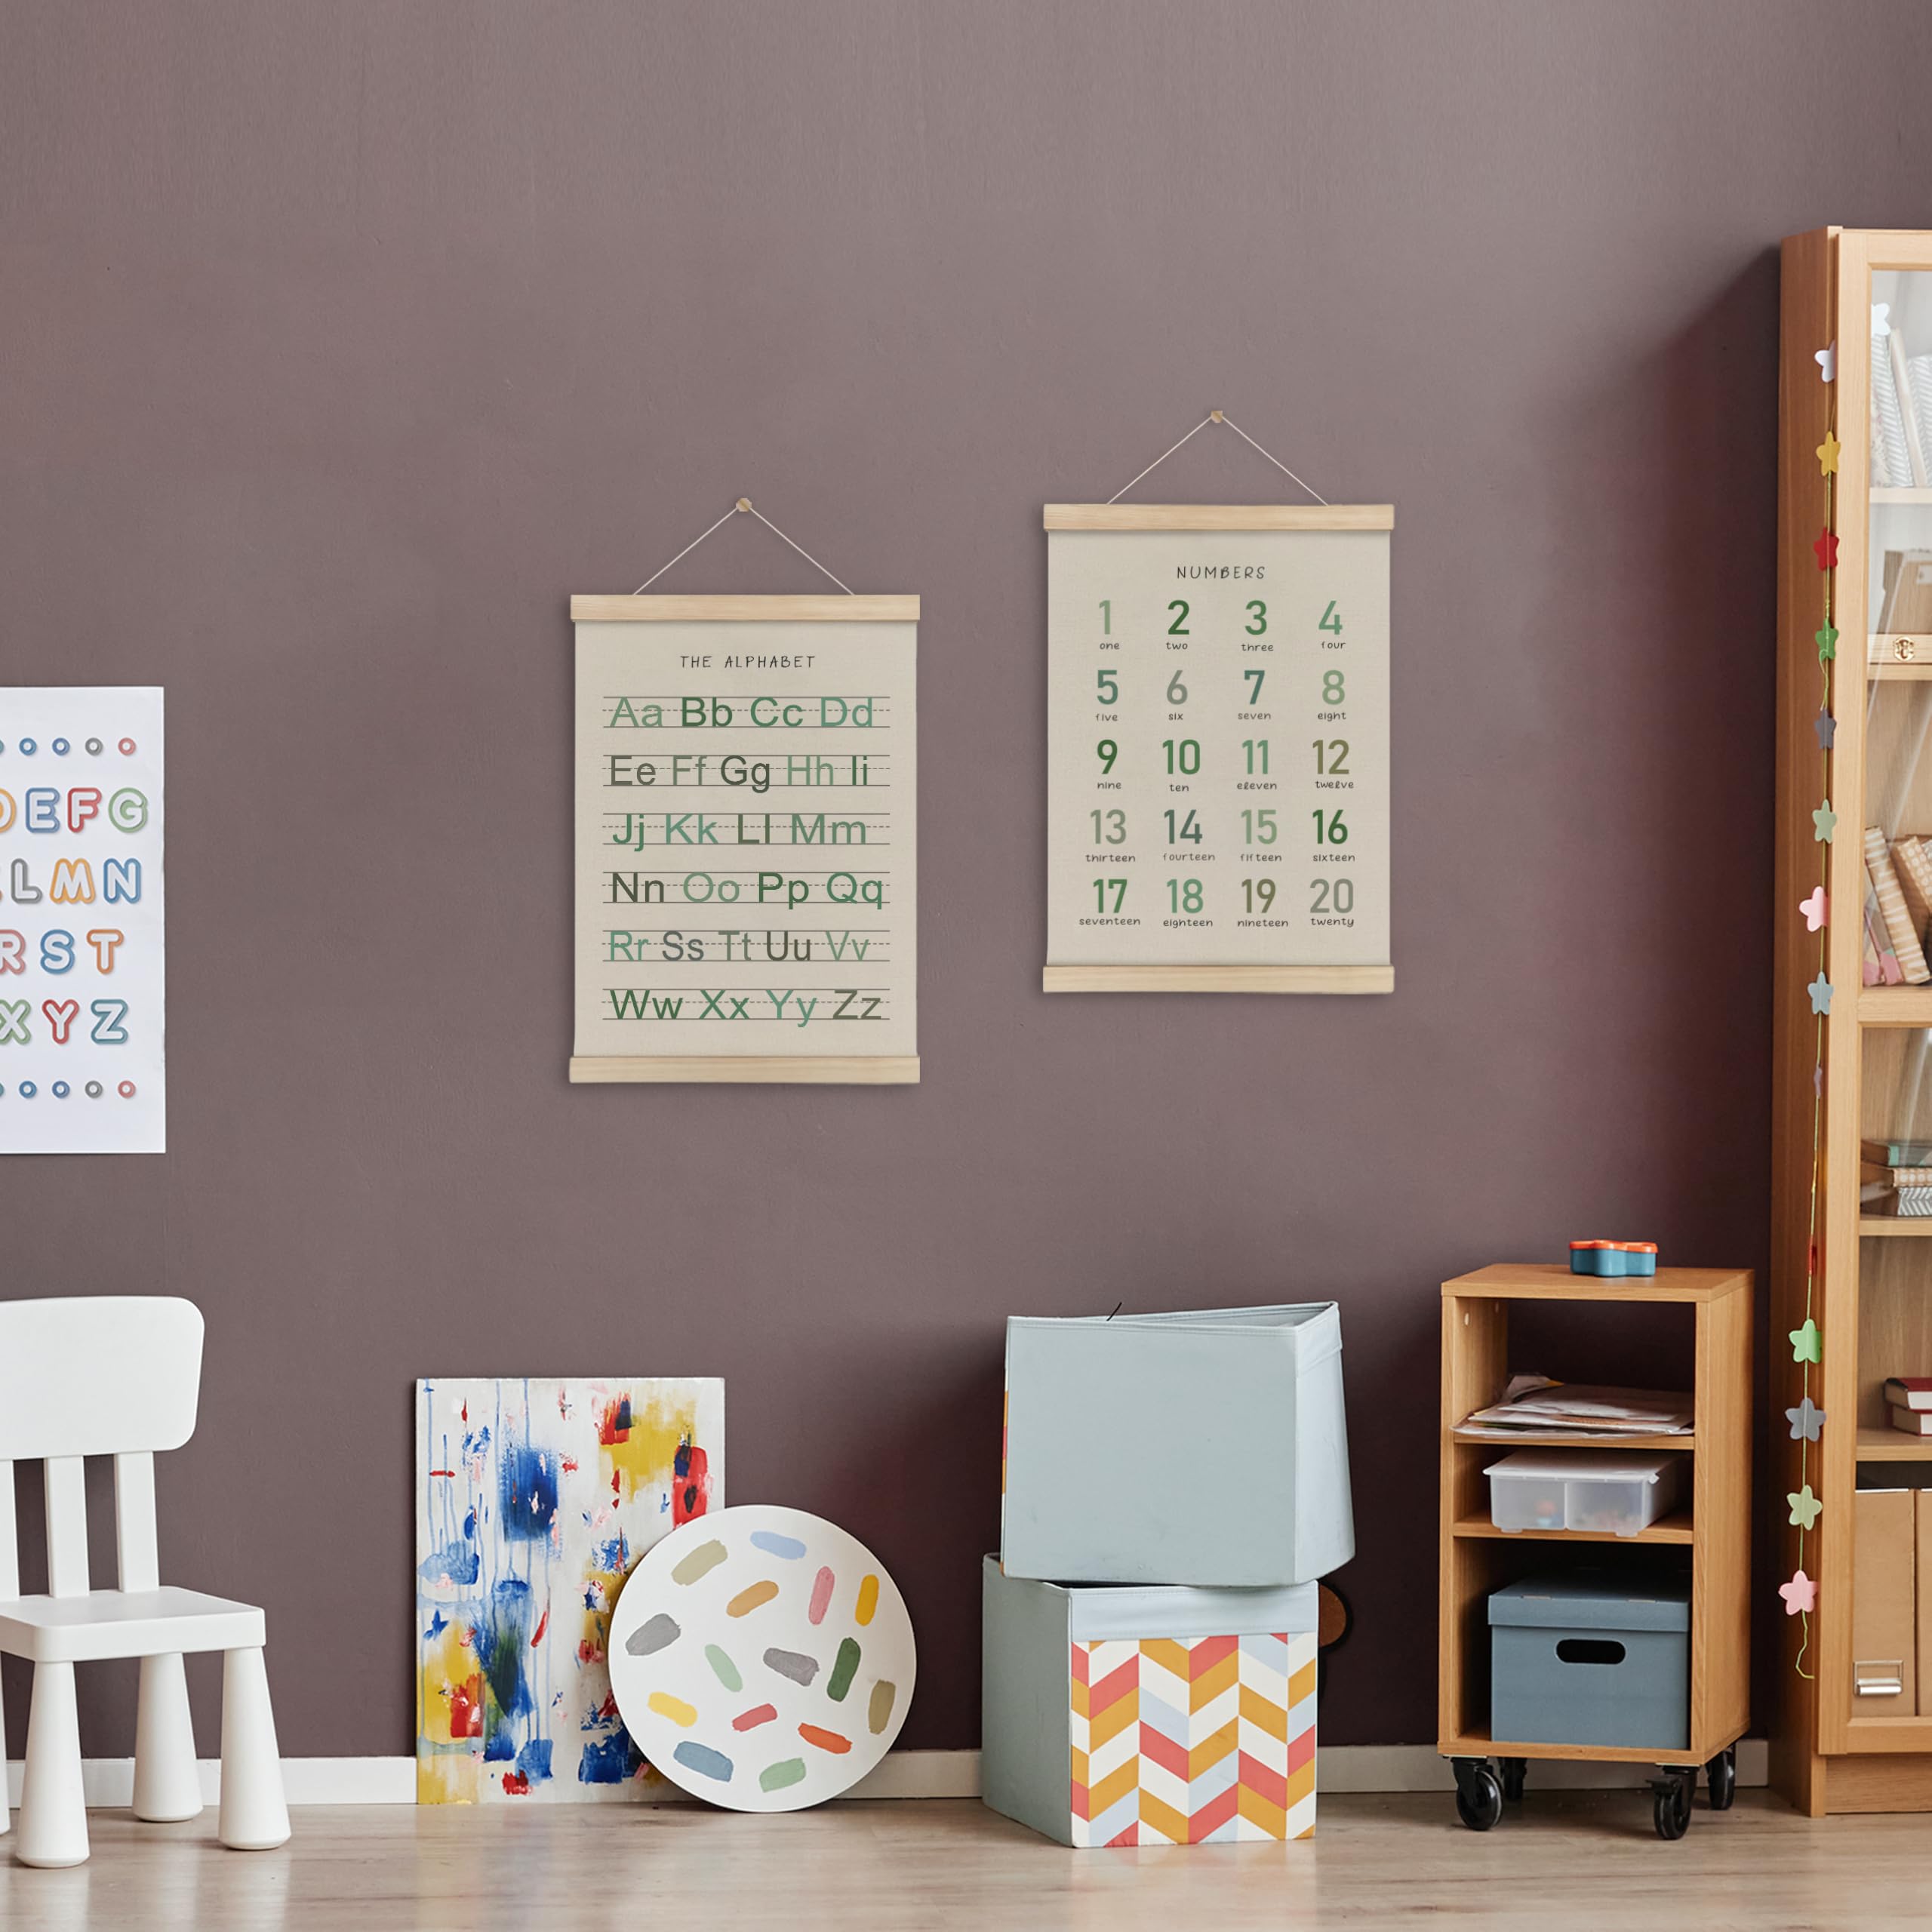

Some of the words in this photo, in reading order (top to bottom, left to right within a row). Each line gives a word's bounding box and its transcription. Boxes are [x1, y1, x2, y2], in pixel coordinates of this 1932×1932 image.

[1177, 565, 1265, 580] NUMBERS
[1098, 599, 1111, 635] 1
[1168, 599, 1190, 635] 2
[1244, 599, 1267, 635] 3
[1318, 600, 1343, 635] 4
[680, 655, 712, 669] THE
[724, 655, 816, 669] ALPHABET
[1099, 642, 1120, 651] one
[1165, 641, 1189, 651] two
[1241, 644, 1274, 652] three
[1321, 641, 1346, 650] four
[1097, 669, 1118, 706] 5
[1166, 669, 1188, 706] 6
[1244, 669, 1266, 705] 7
[1321, 669, 1346, 706] 8
[610, 696, 664, 728] Aa
[680, 696, 734, 728] Bb
[749, 696, 804, 728] Cc
[820, 696, 874, 728] Dd
[1095, 713, 1118, 722] five
[1168, 712, 1183, 721] six
[1317, 712, 1347, 722] eight
[1097, 739, 1118, 775] 9
[1162, 739, 1201, 775] 10
[1241, 739, 1269, 775] 11
[1312, 739, 1349, 775] 12
[609, 755, 657, 786] Ee
[672, 755, 707, 786] Ff
[719, 755, 772, 794] Gg
[786, 755, 835, 786] Hh
[851, 755, 869, 786] Ii
[1097, 781, 1121, 790] nine
[1169, 783, 1189, 792] ten
[1236, 781, 1278, 790] eleven
[1315, 780, 1354, 789] twelve
[611, 813, 645, 853] Jj
[664, 813, 720, 845] Kk
[737, 813, 771, 845] Ll
[791, 813, 867, 845] Mm
[1090, 808, 1127, 845] 13
[1164, 809, 1203, 844] 14
[1241, 809, 1278, 845] 15
[1312, 809, 1349, 844] 16
[1085, 854, 1136, 863] thirteen
[1163, 853, 1216, 861] fourteen
[1240, 854, 1282, 862] fifteen
[1312, 854, 1355, 862] sixteen
[611, 871, 666, 904] Nn
[682, 871, 741, 904] Oo
[757, 871, 810, 910] Pp
[826, 871, 883, 910] Qq
[1093, 878, 1128, 914] 17
[1166, 878, 1204, 914] 18
[1241, 878, 1276, 914] 19
[1309, 878, 1354, 914] 20
[1079, 917, 1141, 925] seventeen
[1162, 918, 1214, 929] eighteen
[1237, 919, 1289, 928] nineteen
[1310, 918, 1355, 928] twenty
[610, 930, 650, 962] Rr
[660, 930, 706, 962] Ss
[717, 930, 752, 962] Tt
[765, 930, 812, 962] Uu
[825, 930, 871, 962] Vv
[609, 989, 685, 1020] Ww
[698, 989, 751, 1020] Xx
[764, 989, 818, 1029] Yy
[832, 989, 883, 1020] Zz
